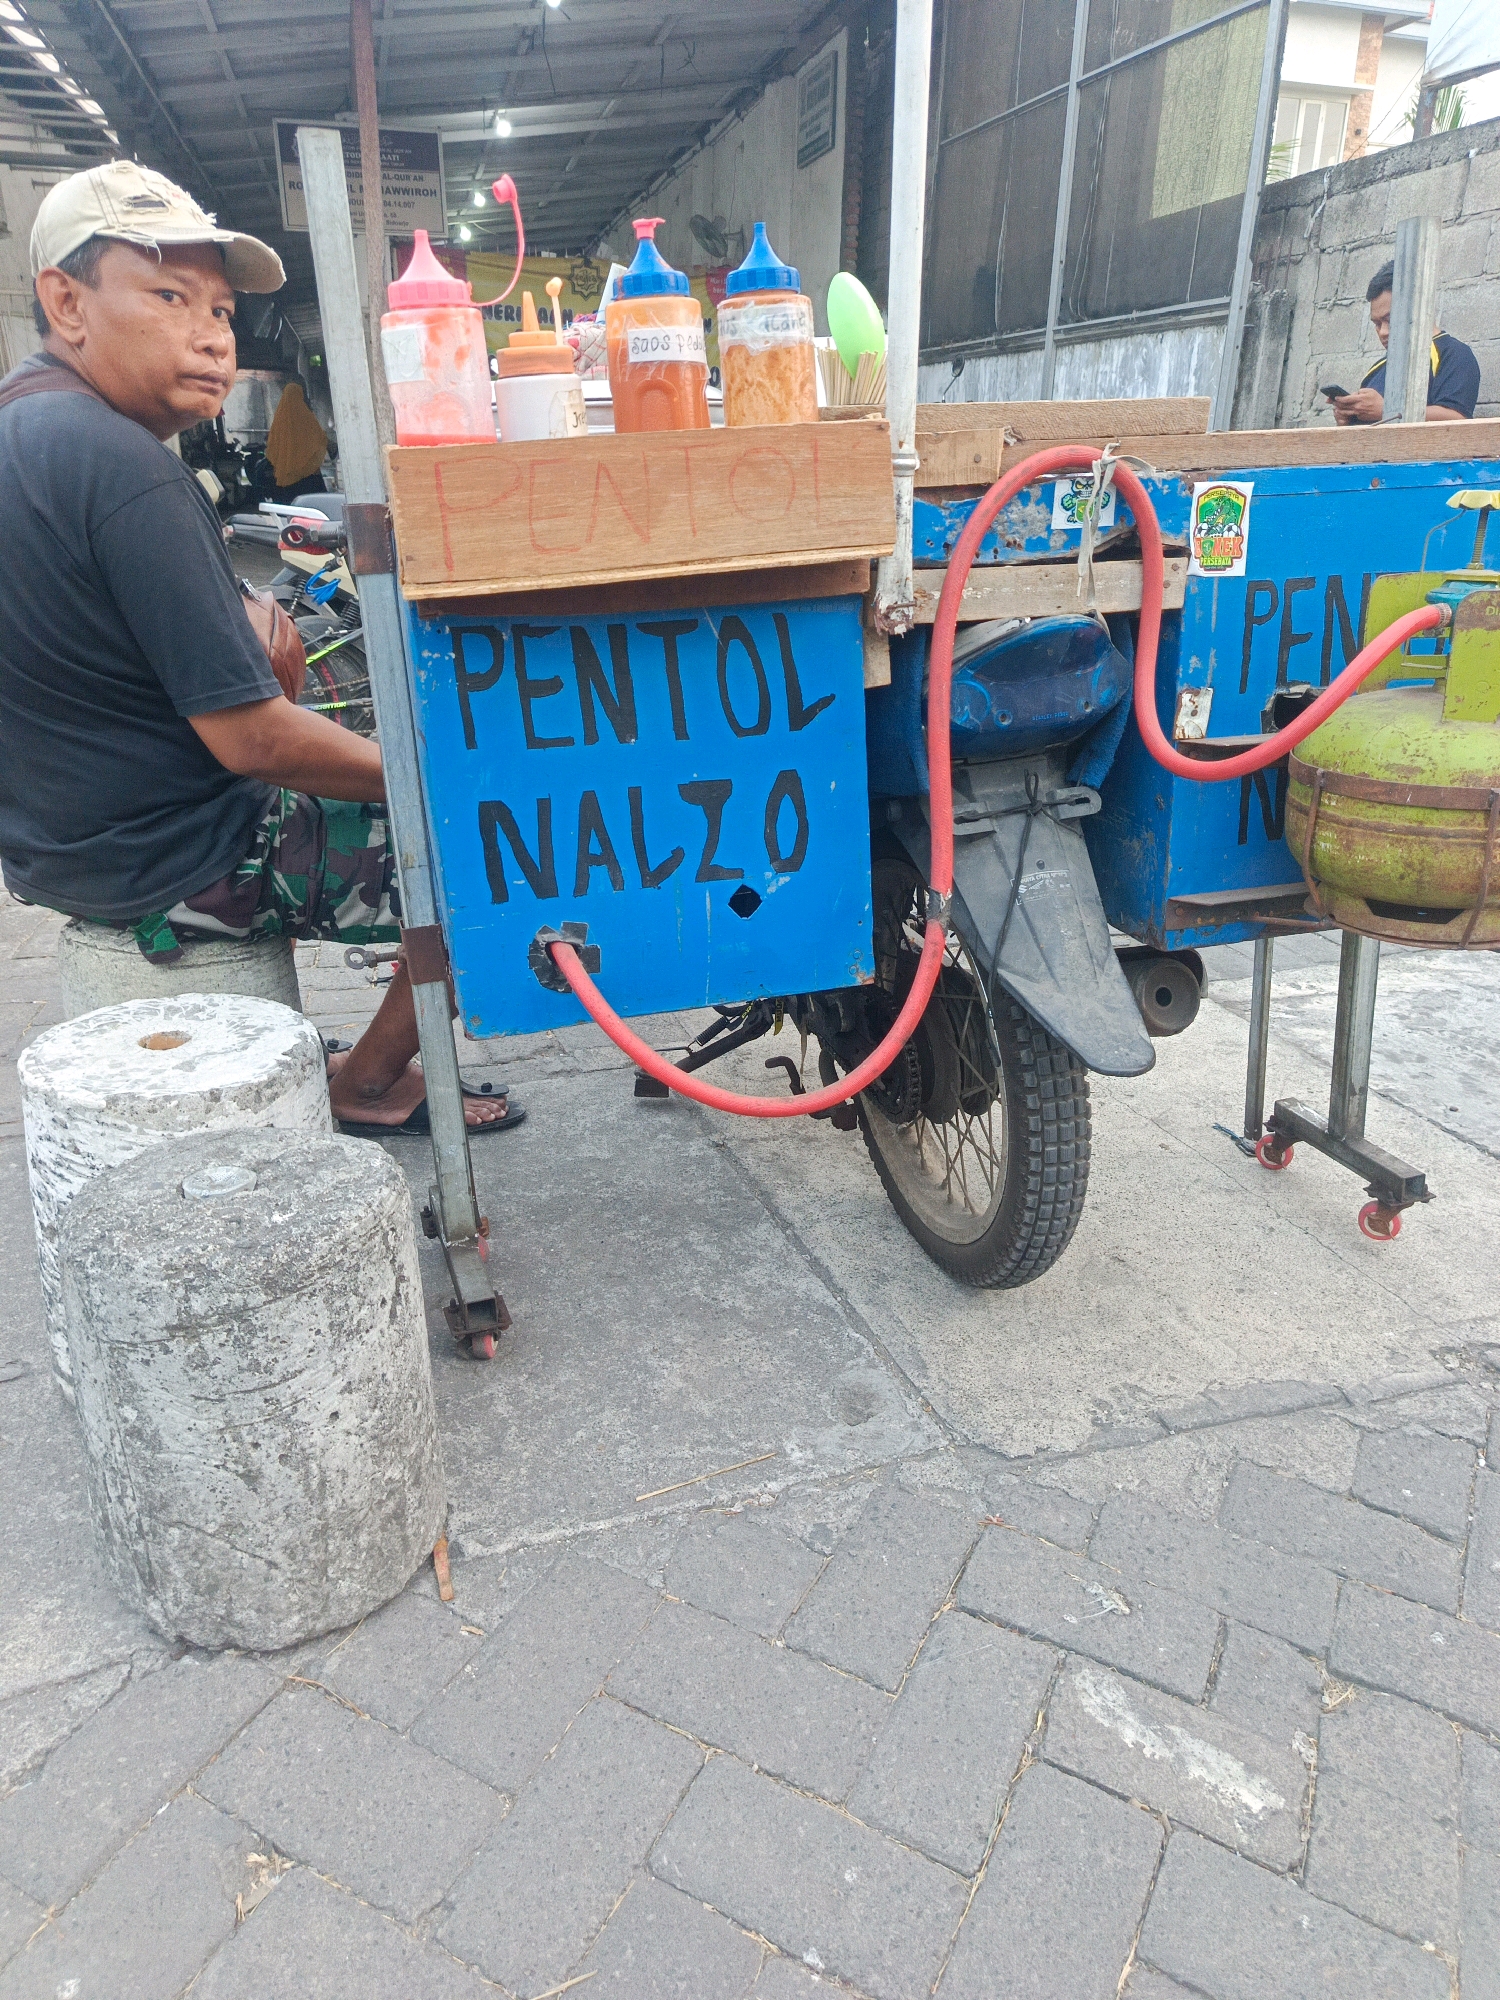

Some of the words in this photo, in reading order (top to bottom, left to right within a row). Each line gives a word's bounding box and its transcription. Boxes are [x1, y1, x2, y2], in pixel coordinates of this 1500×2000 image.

[434, 437, 862, 576] PENTOL
[450, 612, 836, 750] PENTOL
[478, 769, 810, 904] NALZO
